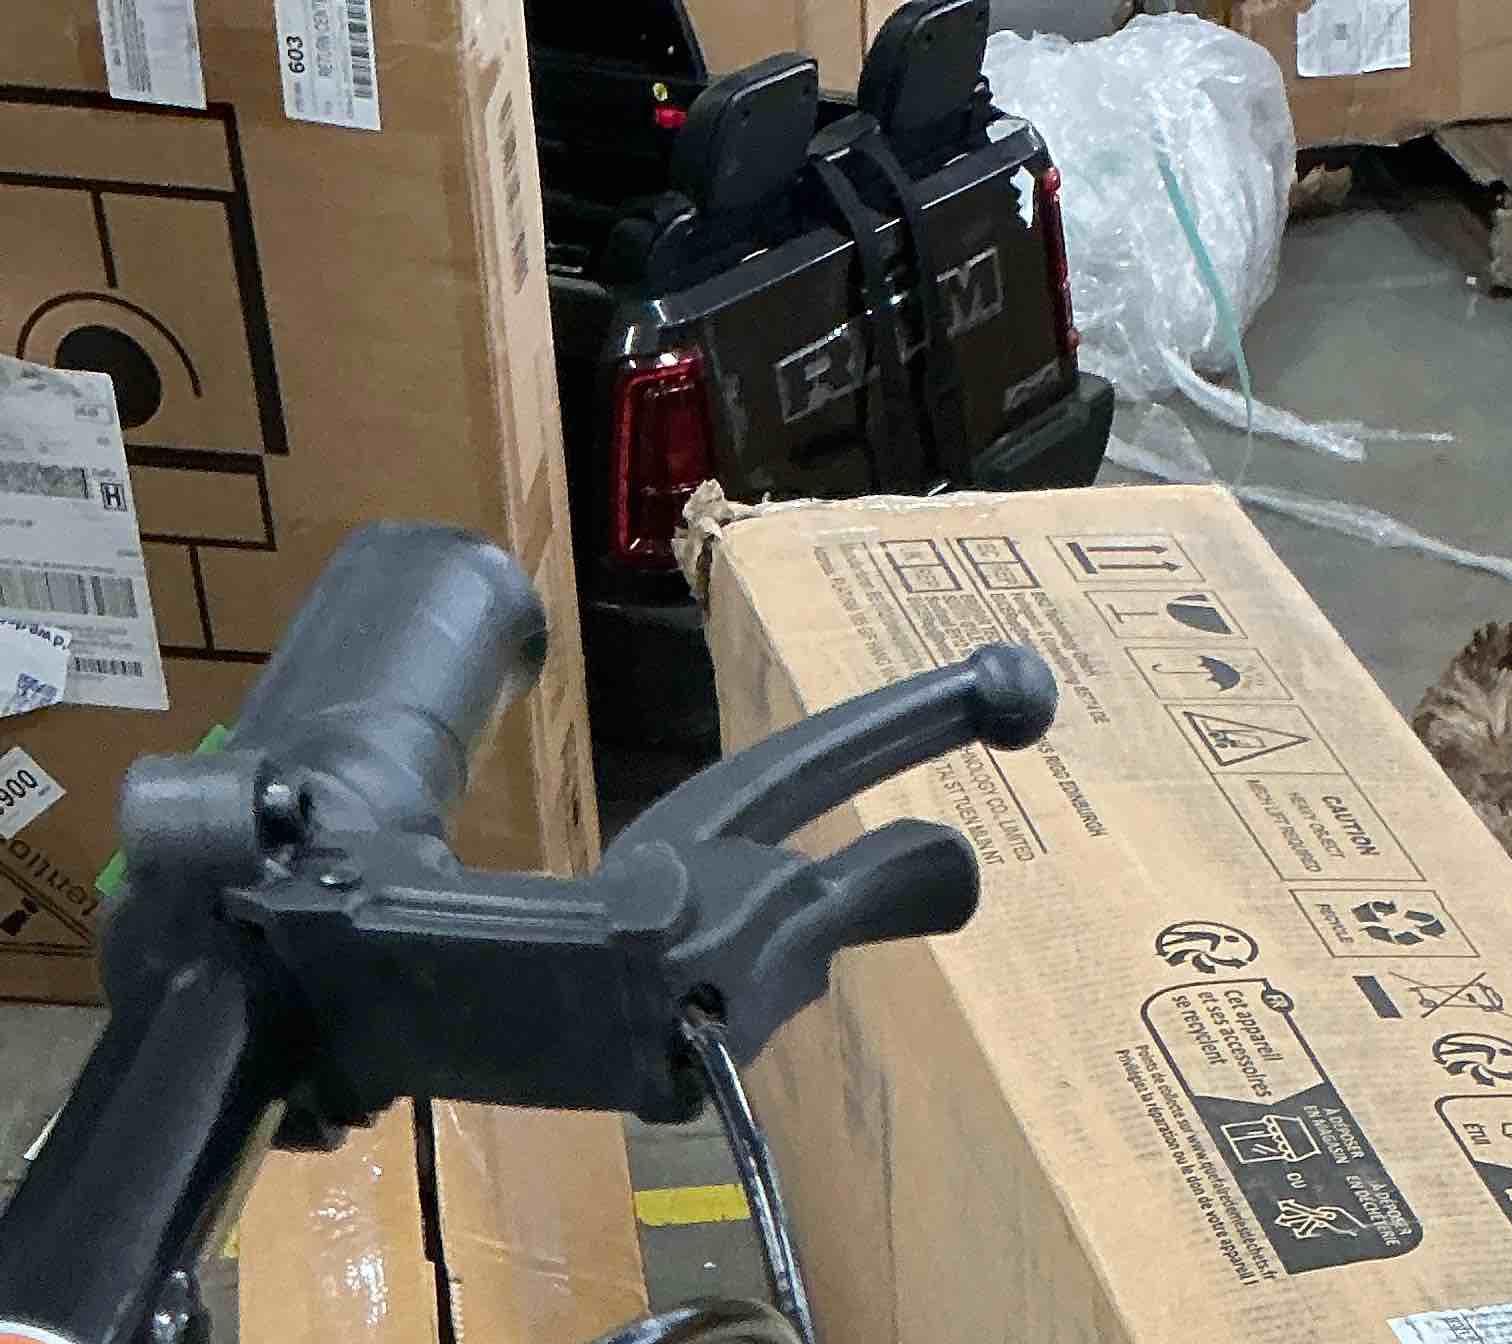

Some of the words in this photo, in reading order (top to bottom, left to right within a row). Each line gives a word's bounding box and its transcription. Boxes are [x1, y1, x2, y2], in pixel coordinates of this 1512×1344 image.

[286, 35, 305, 74] 603
[1320, 796, 1381, 855] CAUTION
[1169, 995, 1193, 1008] se
[1195, 991, 1218, 1003] et
[1221, 990, 1251, 1009] Cet
[1206, 1006, 1231, 1025] ses
[1175, 1010, 1231, 1065] recyclent
[1229, 1010, 1285, 1061] appareil
[1217, 1028, 1279, 1097] accessoires
[1462, 1123, 1496, 1144] ÉTUI
[1283, 1172, 1308, 1188] OU
